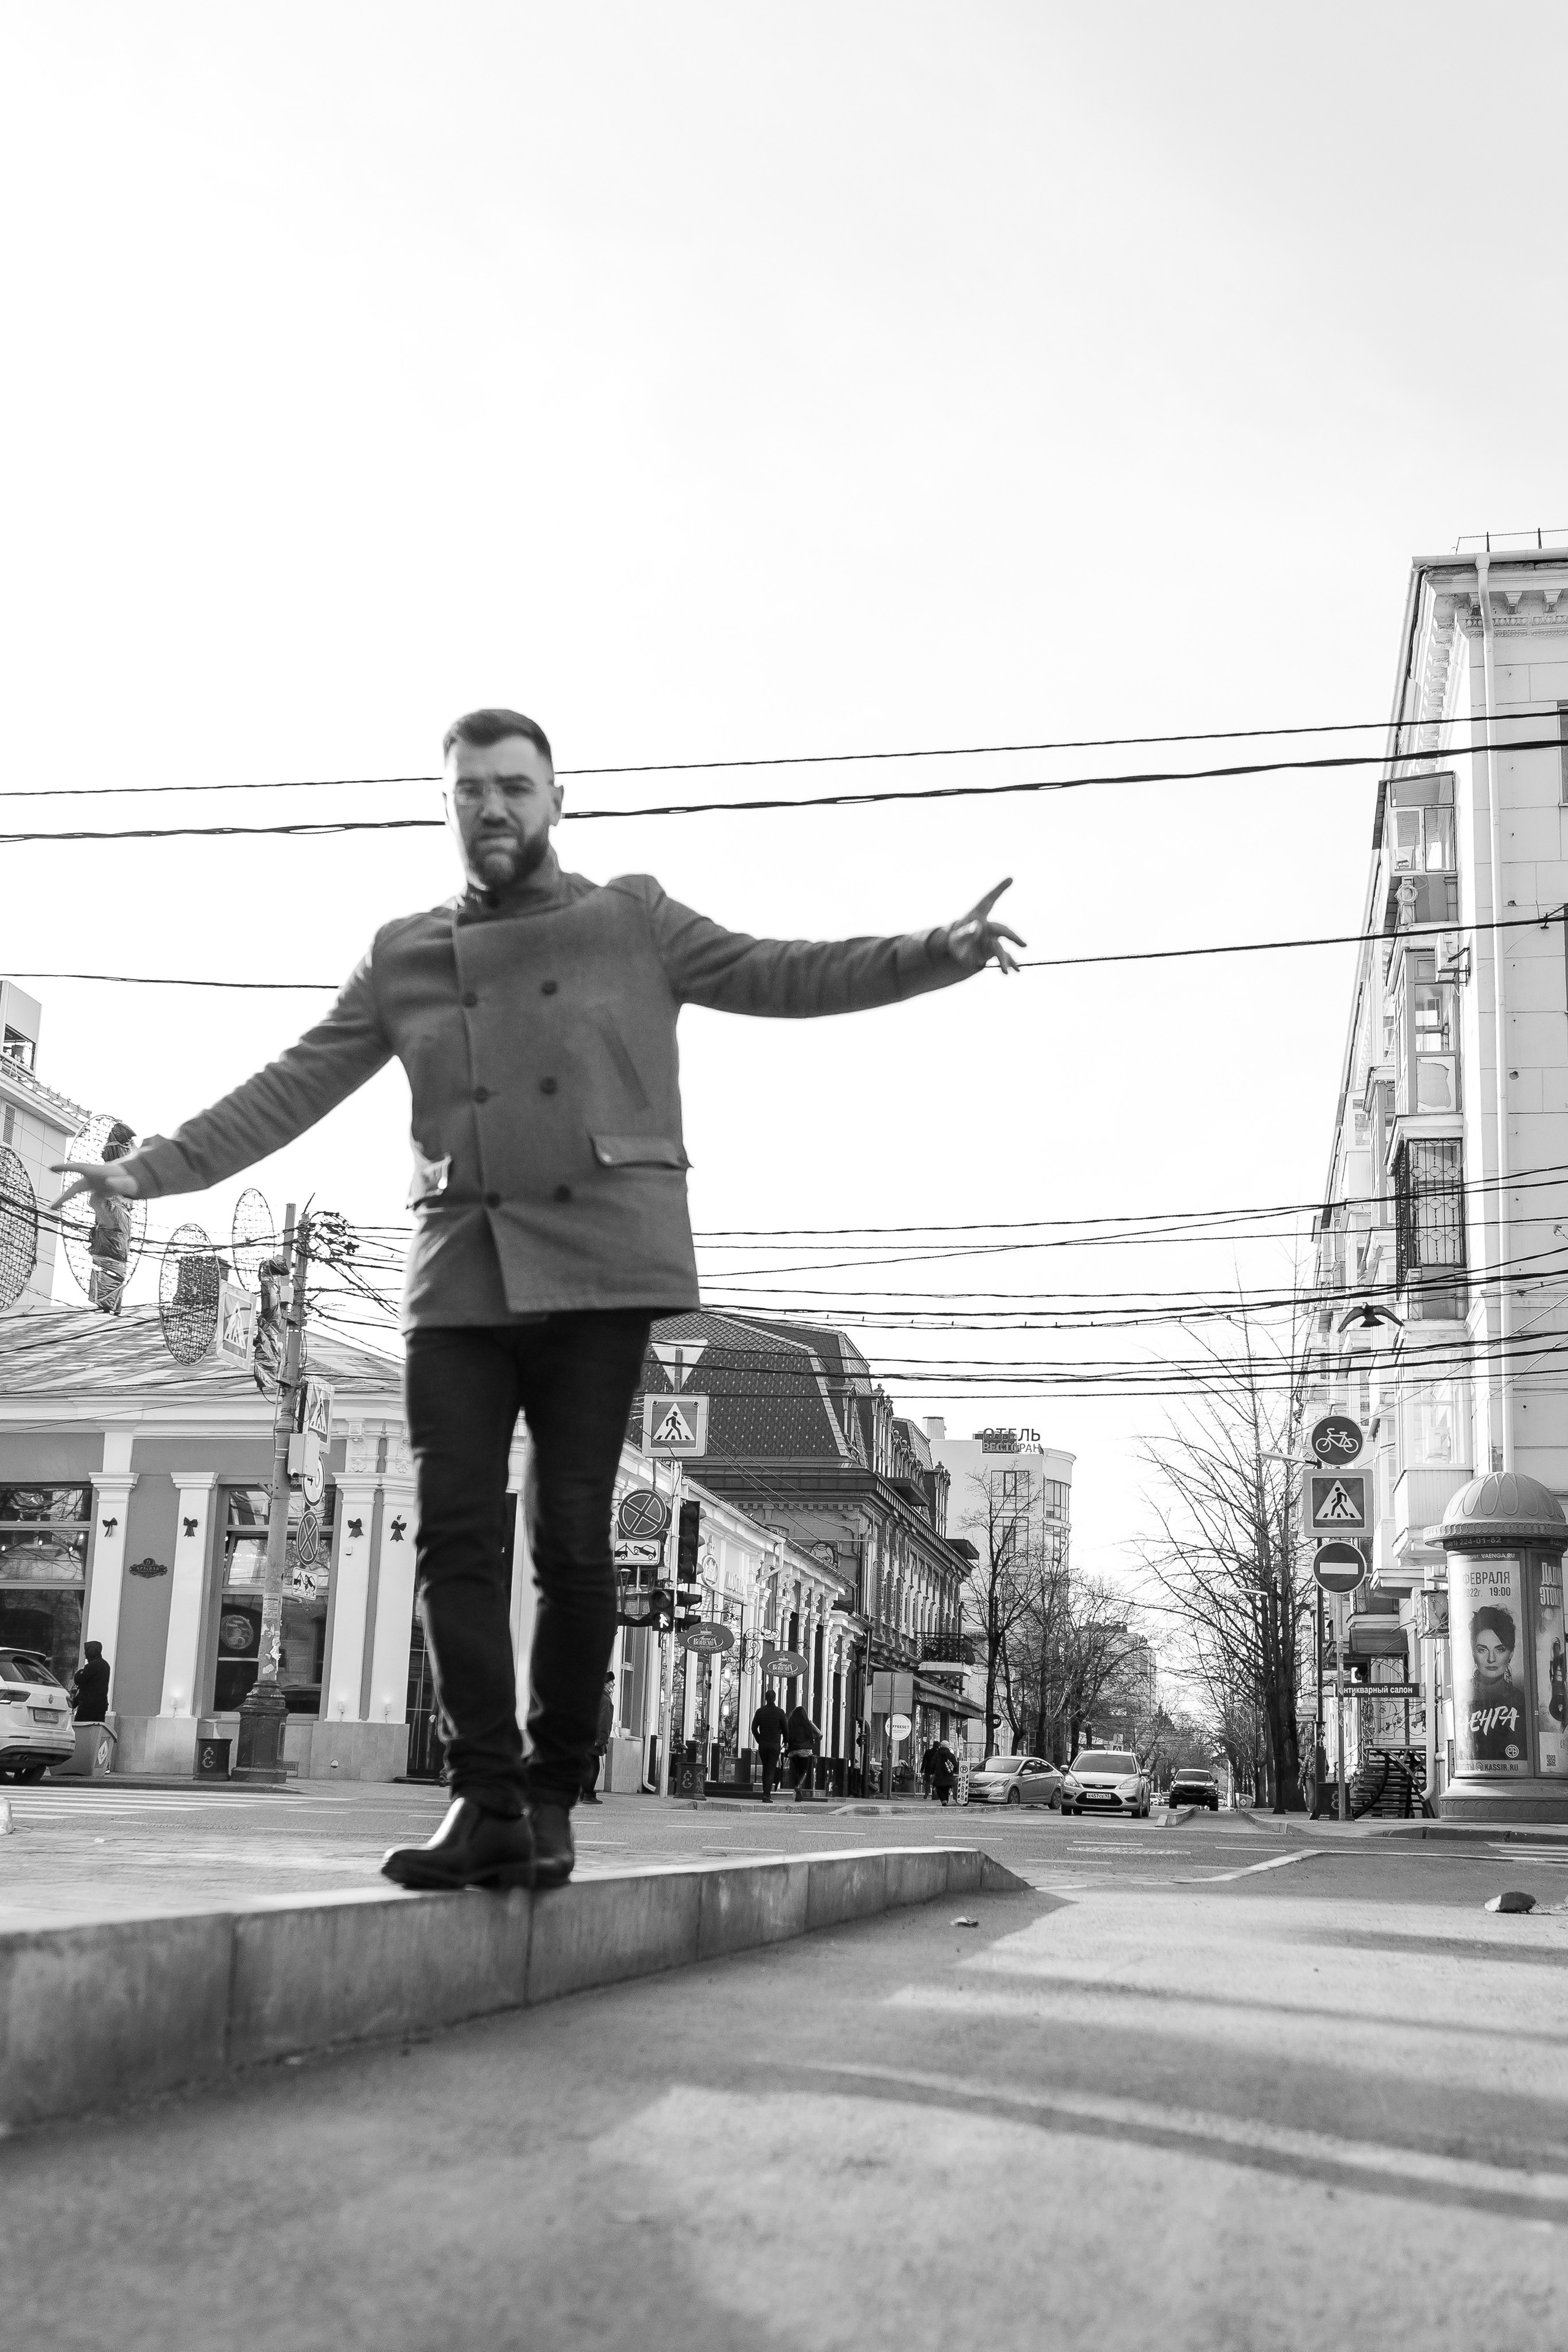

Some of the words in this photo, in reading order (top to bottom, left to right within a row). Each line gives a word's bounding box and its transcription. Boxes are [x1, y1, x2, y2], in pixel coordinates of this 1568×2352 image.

[983, 1428, 1041, 1441] ОТЕЛЬ
[982, 1442, 1041, 1453] РЕСТОРАН
[1463, 1571, 1510, 1585] ФЕВРАЛЯ
[1489, 1586, 1511, 1597] 19:00
[693, 1637, 717, 1646] BOHEMIA
[1344, 1686, 1389, 1695] нтикварный
